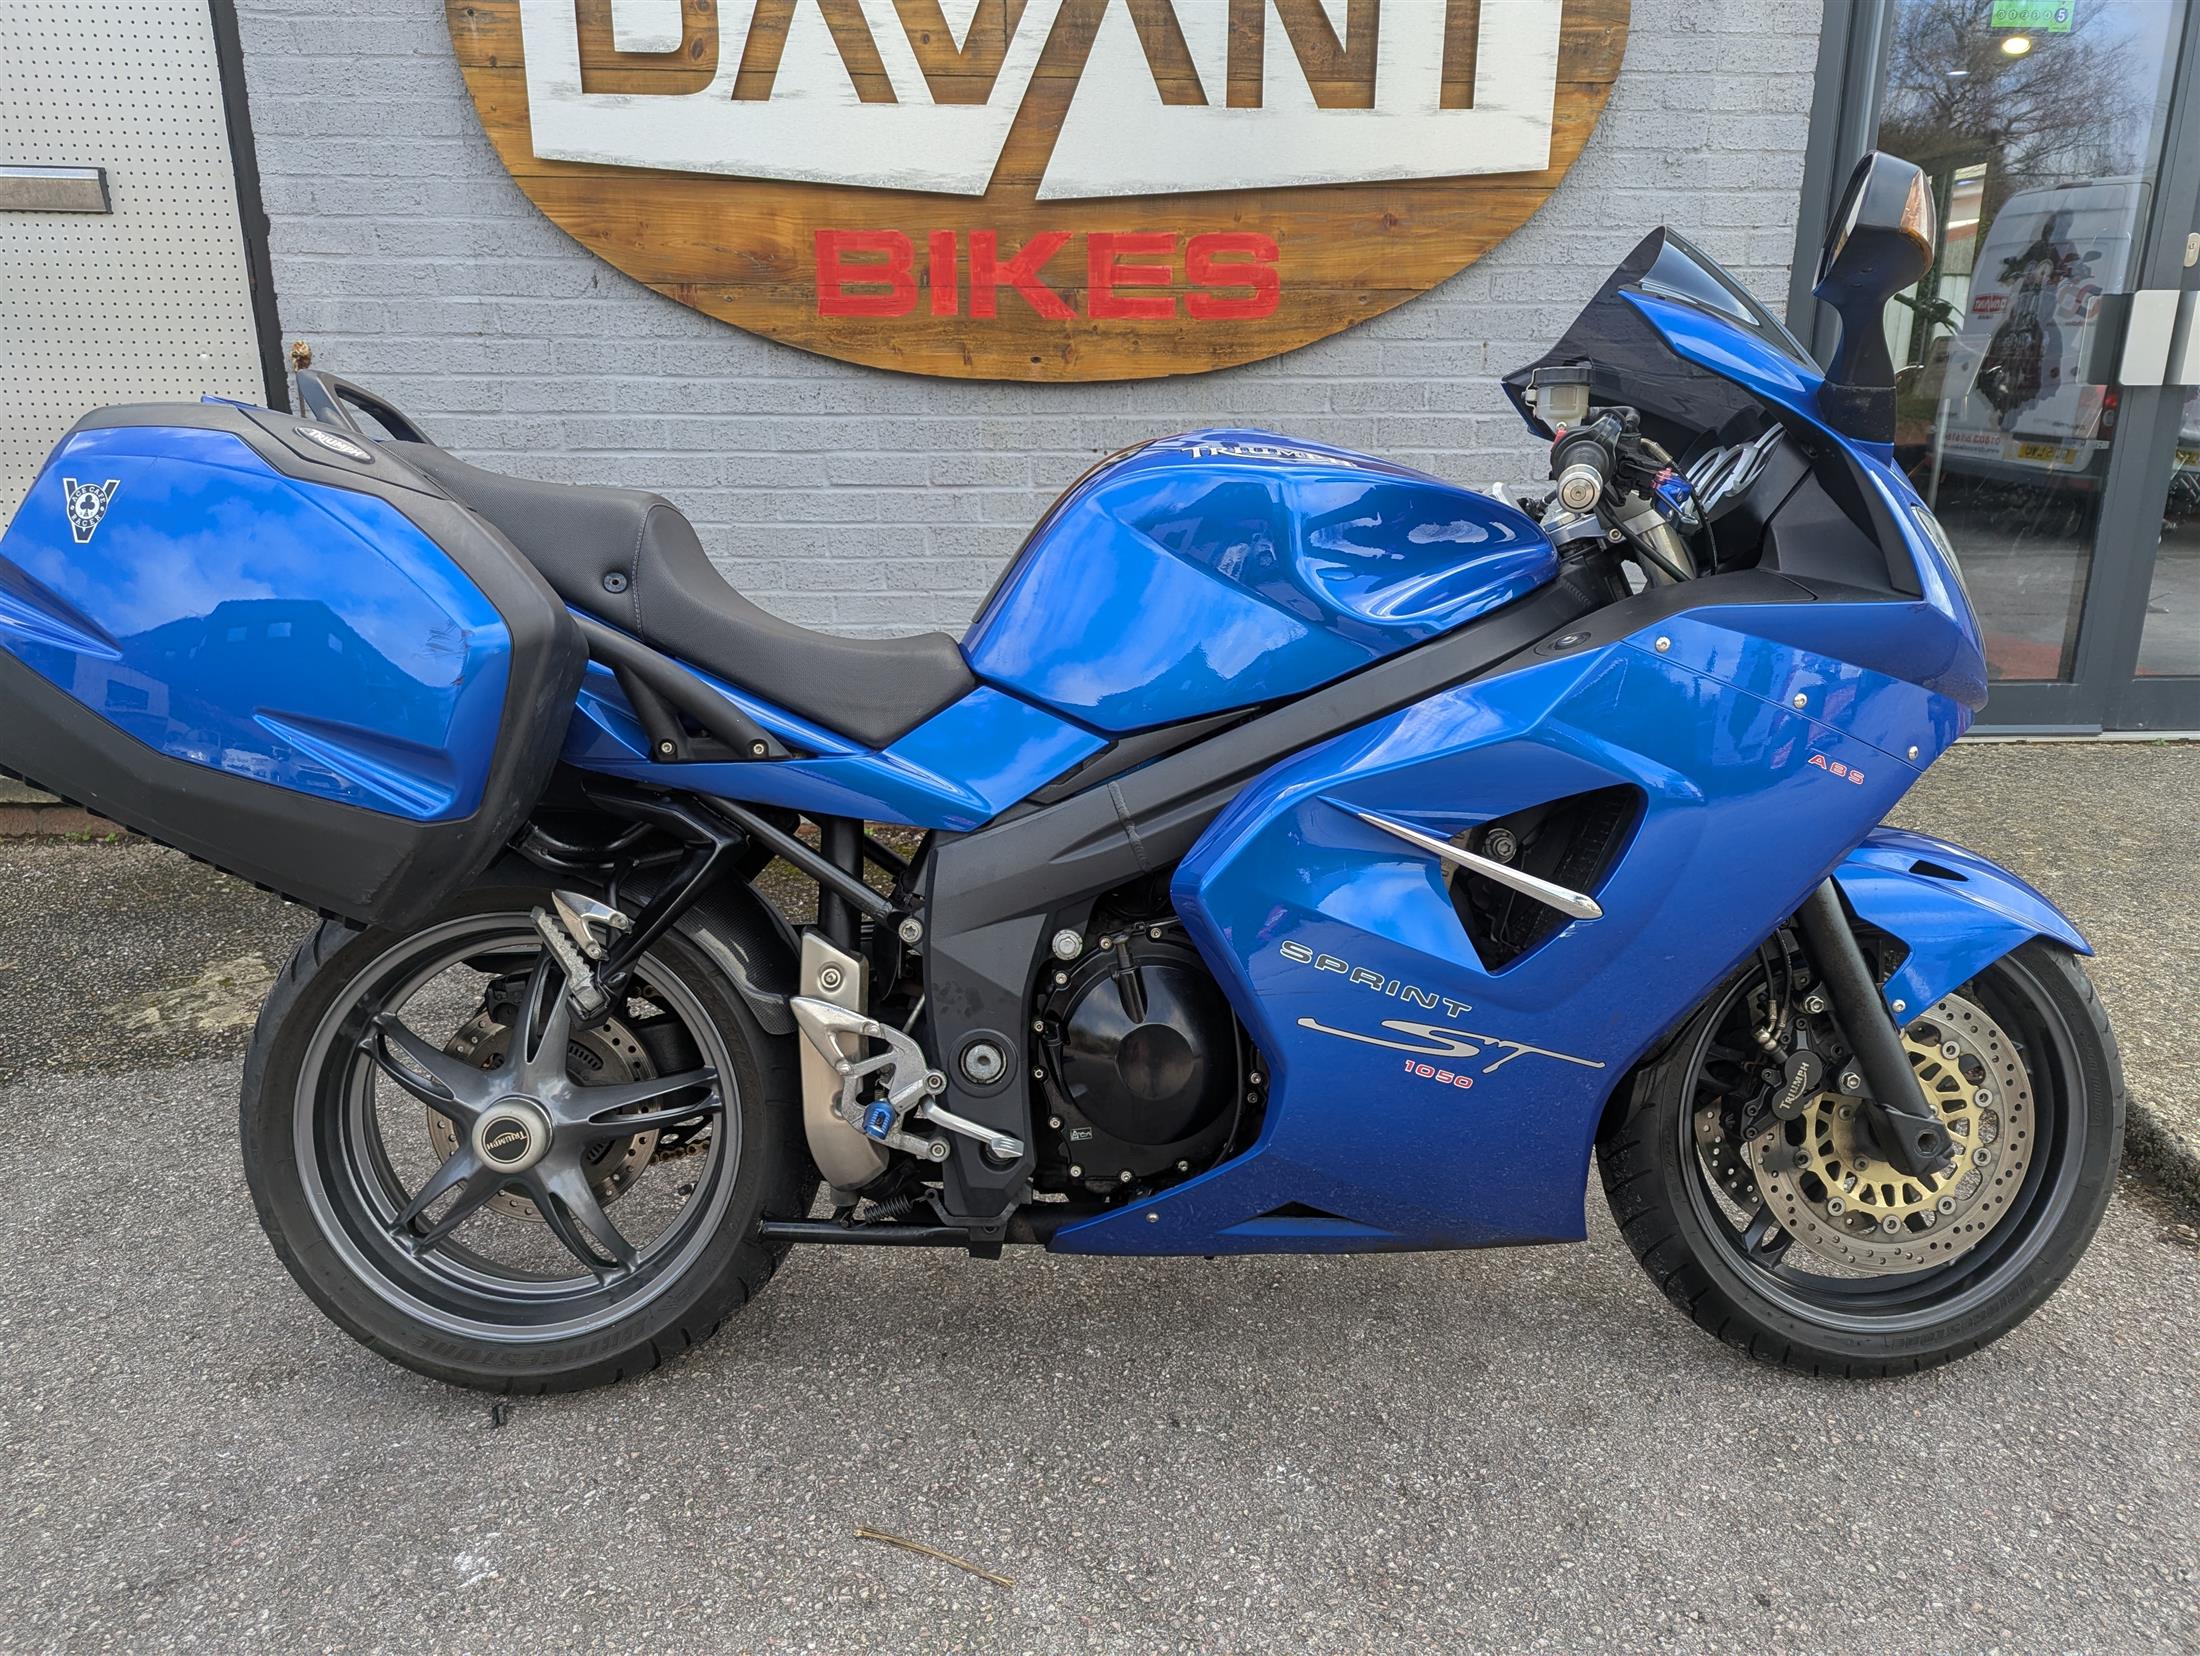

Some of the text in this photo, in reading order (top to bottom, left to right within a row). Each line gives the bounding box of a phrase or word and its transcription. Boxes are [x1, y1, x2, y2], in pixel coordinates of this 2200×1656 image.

[2056, 9, 2067, 22] 5
[815, 229, 1282, 322] BIKES
[309, 428, 364, 457] TRIUMPH
[71, 486, 107, 504] ACE CAFE
[71, 513, 102, 527] RACER
[1808, 754, 1865, 785] ABS
[1279, 940, 1472, 1018] SPRINT
[1297, 1017, 1606, 1074] ST
[1404, 1059, 1474, 1089] 1050
[1779, 1062, 1809, 1109] TRIUMPH
[486, 1130, 528, 1151] TRIUMPH
